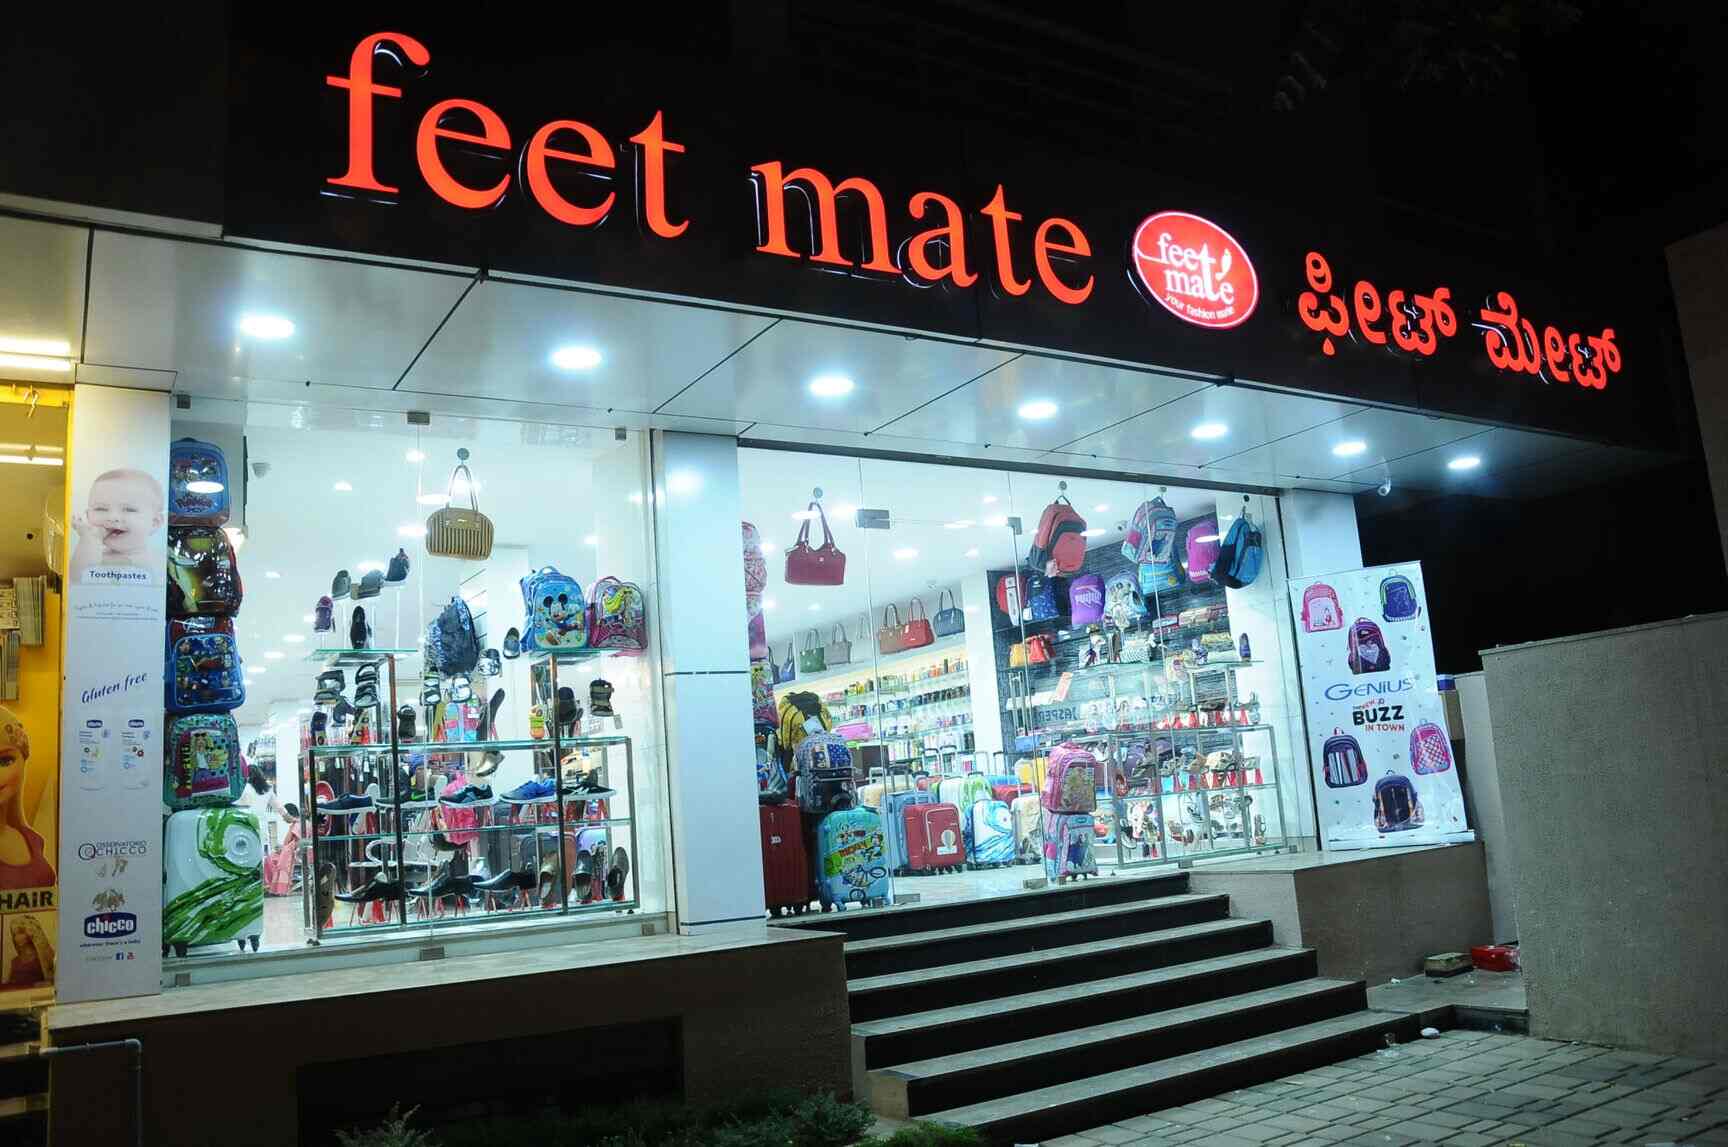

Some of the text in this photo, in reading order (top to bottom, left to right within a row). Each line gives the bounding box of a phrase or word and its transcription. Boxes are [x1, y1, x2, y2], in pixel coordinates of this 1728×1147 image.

[327, 32, 1093, 304] feet mate
[1158, 233, 1216, 271] feet
[1166, 266, 1234, 305] mate
[89, 570, 147, 580] Toothpastes
[81, 673, 147, 704] Gluten free
[1352, 704, 1405, 726] BUZZ
[1377, 723, 1404, 732] TOWN
[87, 918, 134, 935] chicco
